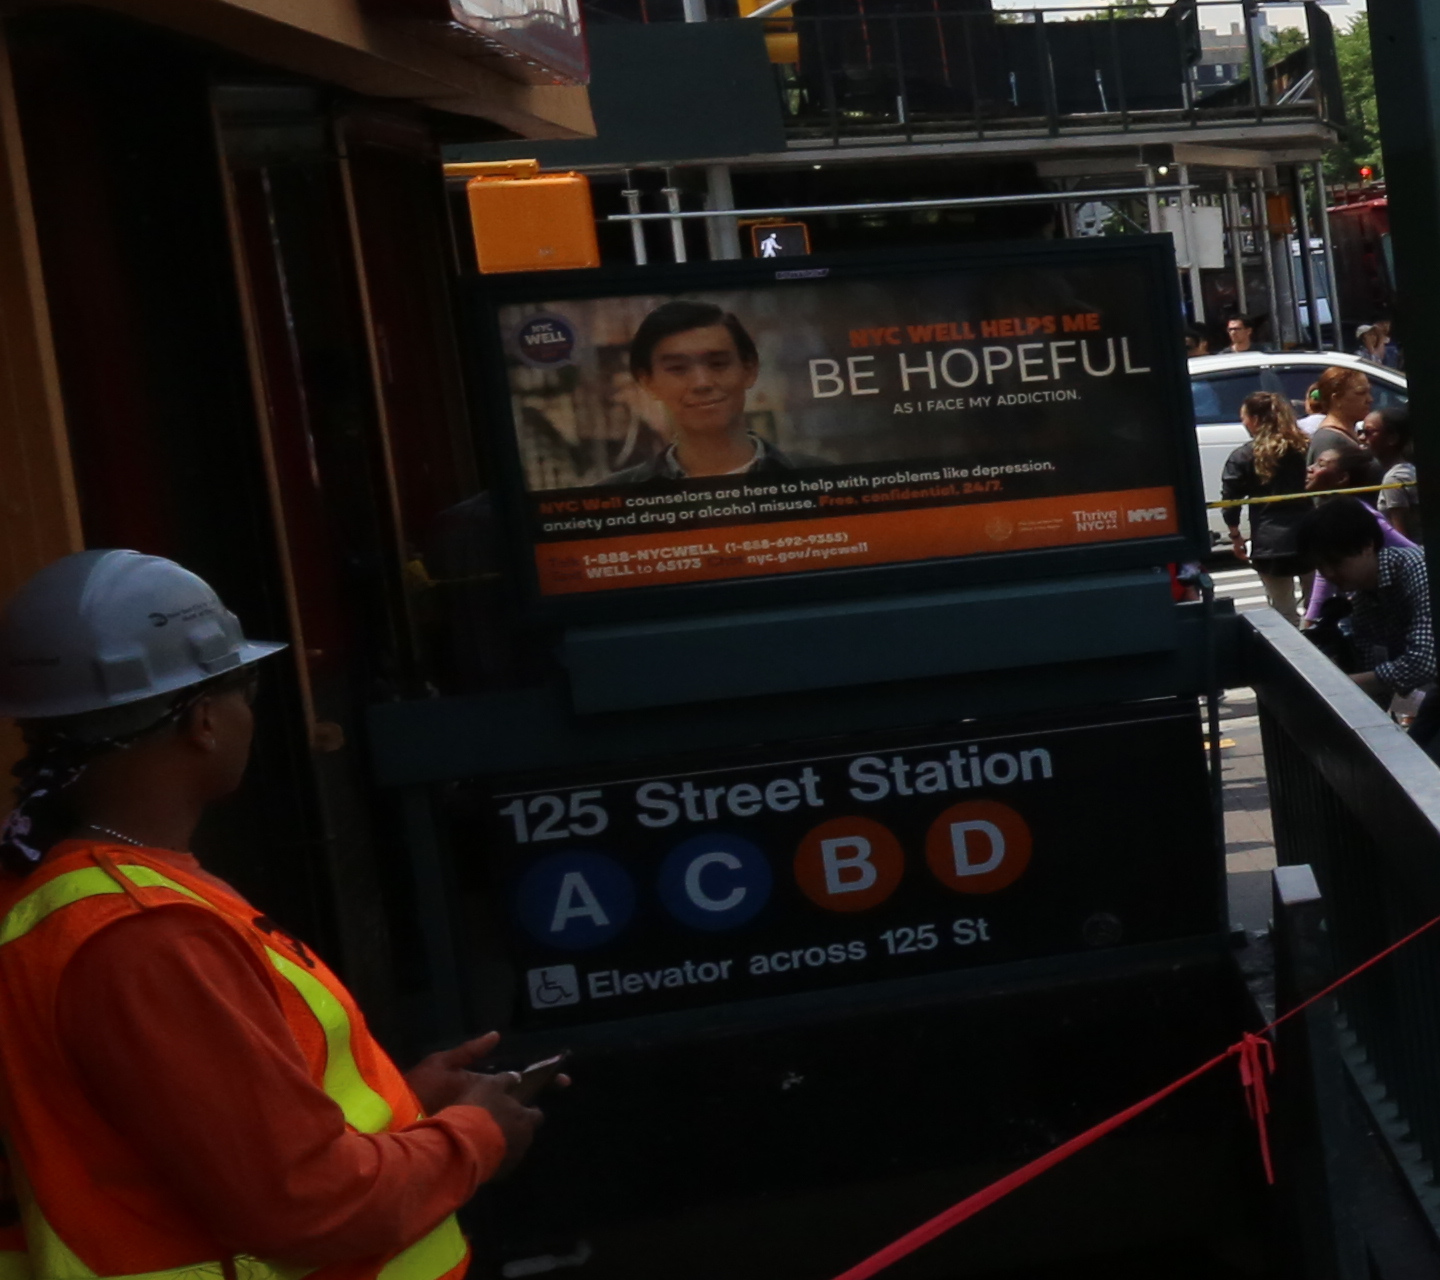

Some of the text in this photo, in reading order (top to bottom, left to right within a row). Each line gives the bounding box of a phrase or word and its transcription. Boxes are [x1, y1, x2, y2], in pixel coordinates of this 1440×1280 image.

[523, 329, 567, 346] WELL
[531, 321, 554, 334] NYC
[848, 312, 1102, 348] NYC WELL HELPS ME
[808, 336, 1151, 400] BE HOPEFUL
[893, 401, 914, 415] AS
[926, 398, 966, 413] FACE
[969, 396, 992, 409] MY
[996, 388, 1082, 408] ADDICTION.
[625, 490, 713, 508] counselors
[715, 487, 741, 500] are
[744, 483, 779, 497] here
[782, 481, 797, 494] to
[800, 478, 834, 496] help
[837, 475, 869, 490] with
[872, 469, 940, 491] problems
[943, 466, 969, 480] like
[972, 459, 1056, 481] depression.
[543, 516, 602, 533] anxiety
[606, 512, 635, 527] and
[639, 509, 677, 526] drug
[680, 509, 695, 520] or
[698, 502, 757, 517] alcohol
[759, 499, 817, 512] misuse.
[1071, 508, 1118, 522] Thrive
[1127, 506, 1168, 523] NYC
[583, 542, 720, 567] 1-888-NYCWELL
[586, 565, 635, 580] WELL
[637, 563, 652, 575] to
[655, 557, 703, 573] 65173
[499, 745, 1055, 844] 125 Street Station
[549, 819, 1005, 933] A C B D
[586, 917, 991, 1001] Elevator across 125 St
